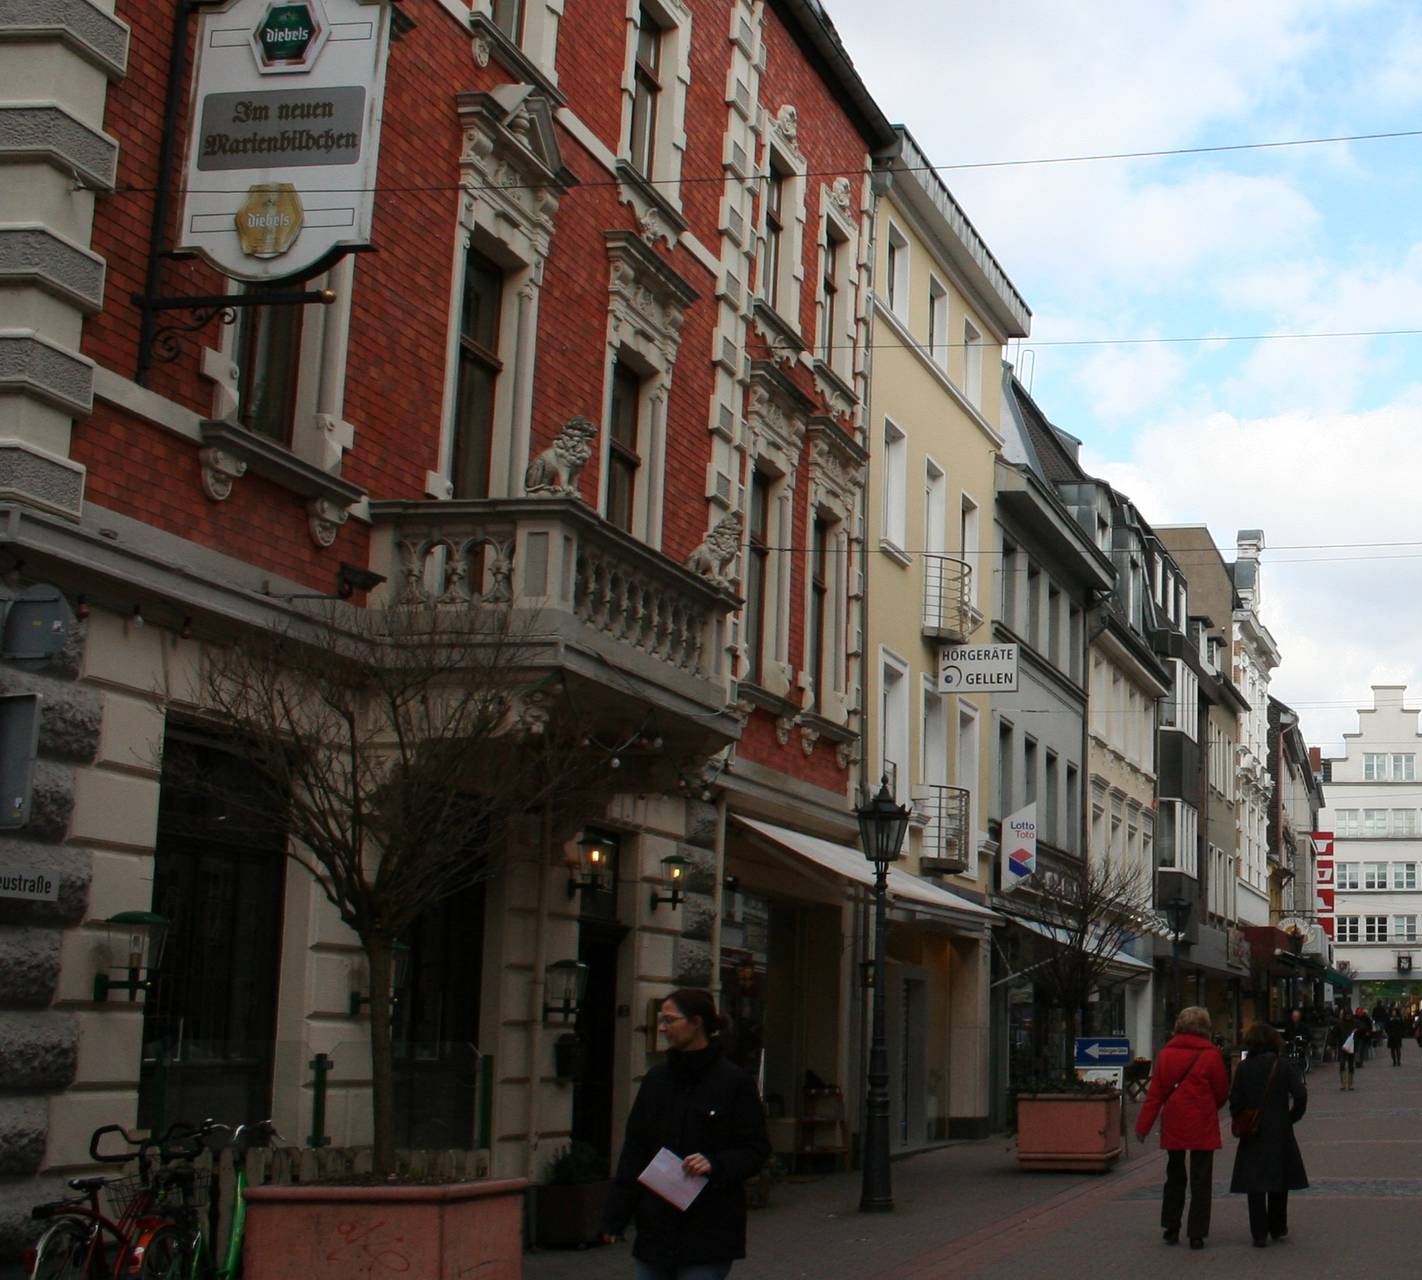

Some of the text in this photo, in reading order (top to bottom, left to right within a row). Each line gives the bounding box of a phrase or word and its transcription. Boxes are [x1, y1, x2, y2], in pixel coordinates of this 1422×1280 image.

[277, 101, 334, 119] neuen
[203, 128, 358, 156] Marienbildchen
[942, 647, 1014, 661] HÖRGERÄTE
[965, 672, 1013, 685] GELLEN
[1010, 821, 1035, 831] Lotto
[1015, 830, 1035, 839] Toto
